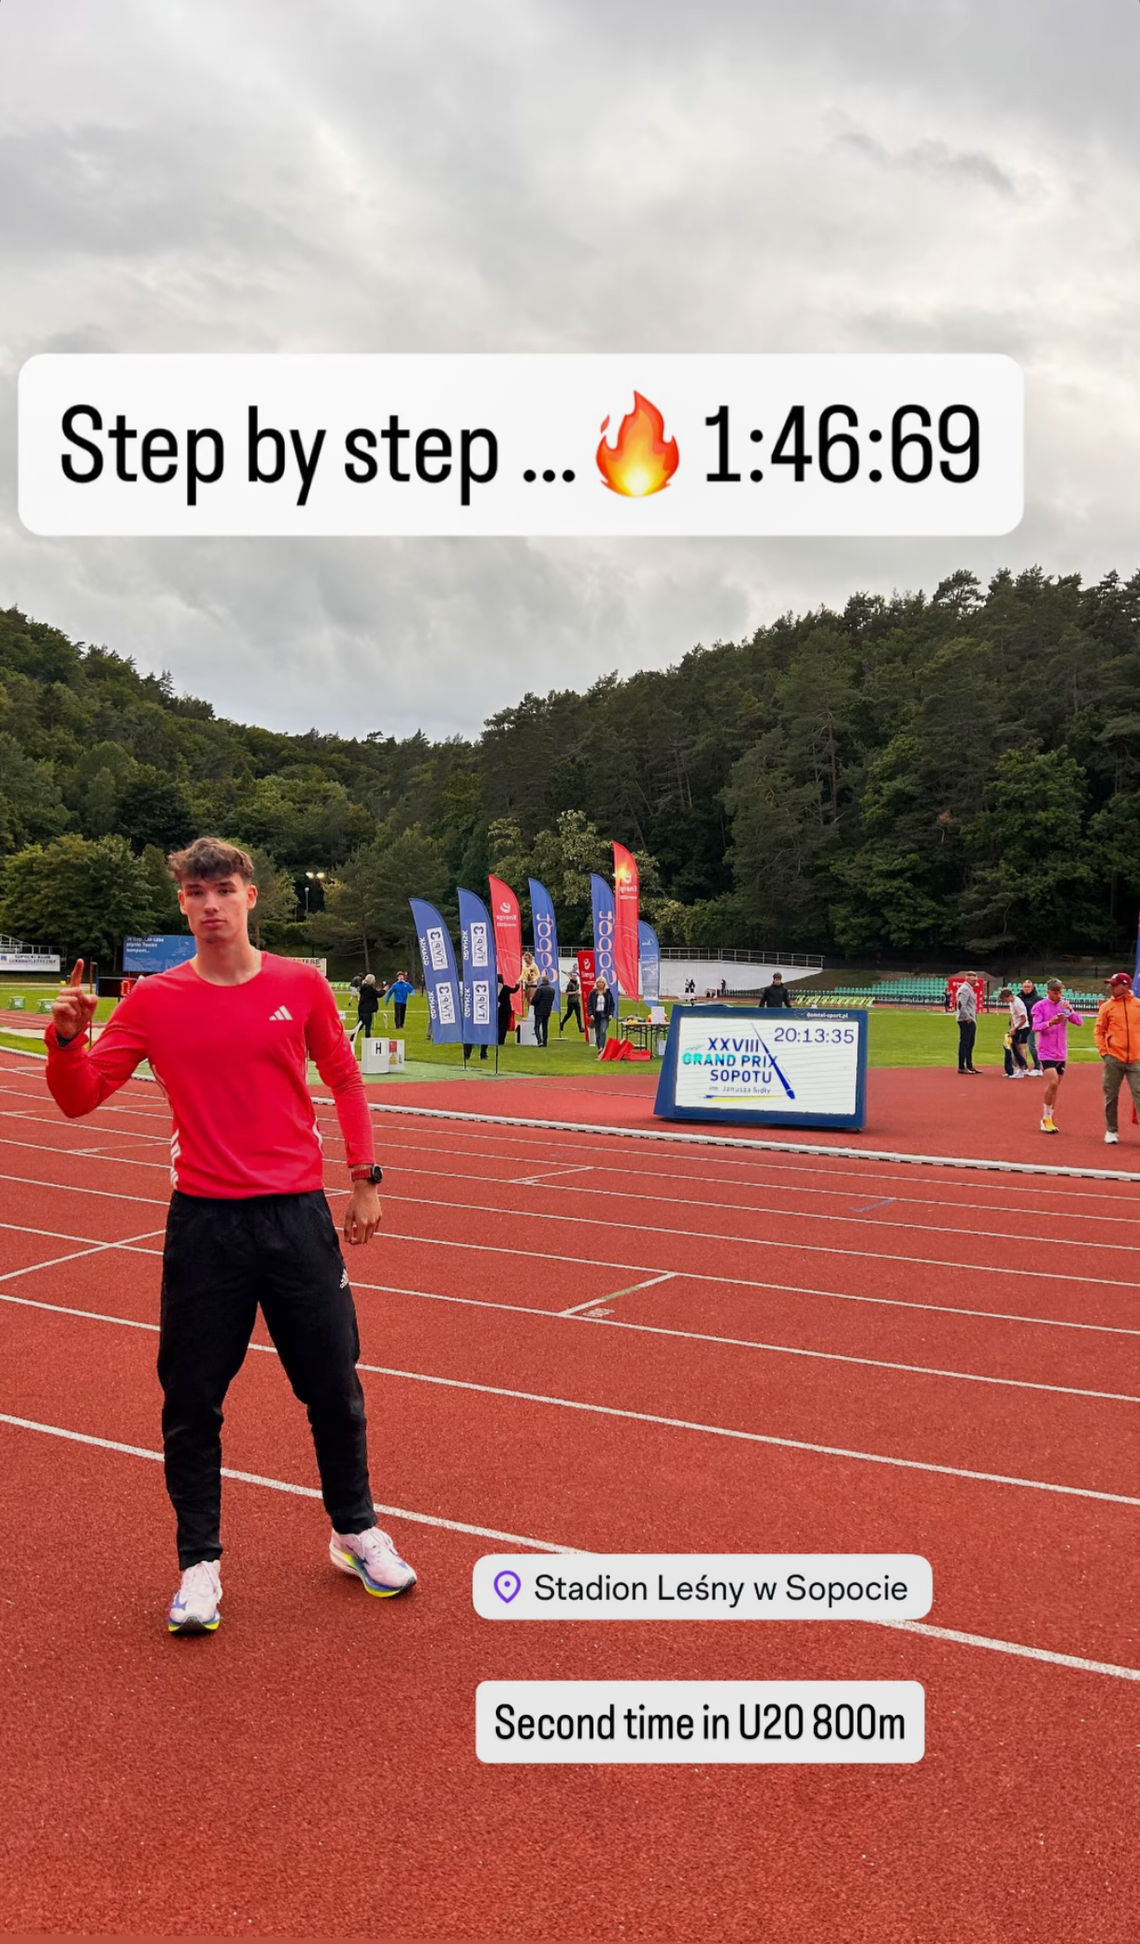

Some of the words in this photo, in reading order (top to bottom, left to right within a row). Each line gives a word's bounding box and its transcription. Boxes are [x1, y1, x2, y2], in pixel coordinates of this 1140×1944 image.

[774, 1027, 855, 1044] 20:13:35
[375, 1042, 382, 1055] H
[708, 1037, 759, 1053] XXVIII
[682, 1052, 737, 1067] GRAND
[741, 1055, 778, 1068] PRIX
[710, 1069, 772, 1084] SOPOTU
[722, 1085, 752, 1093] Janusza
